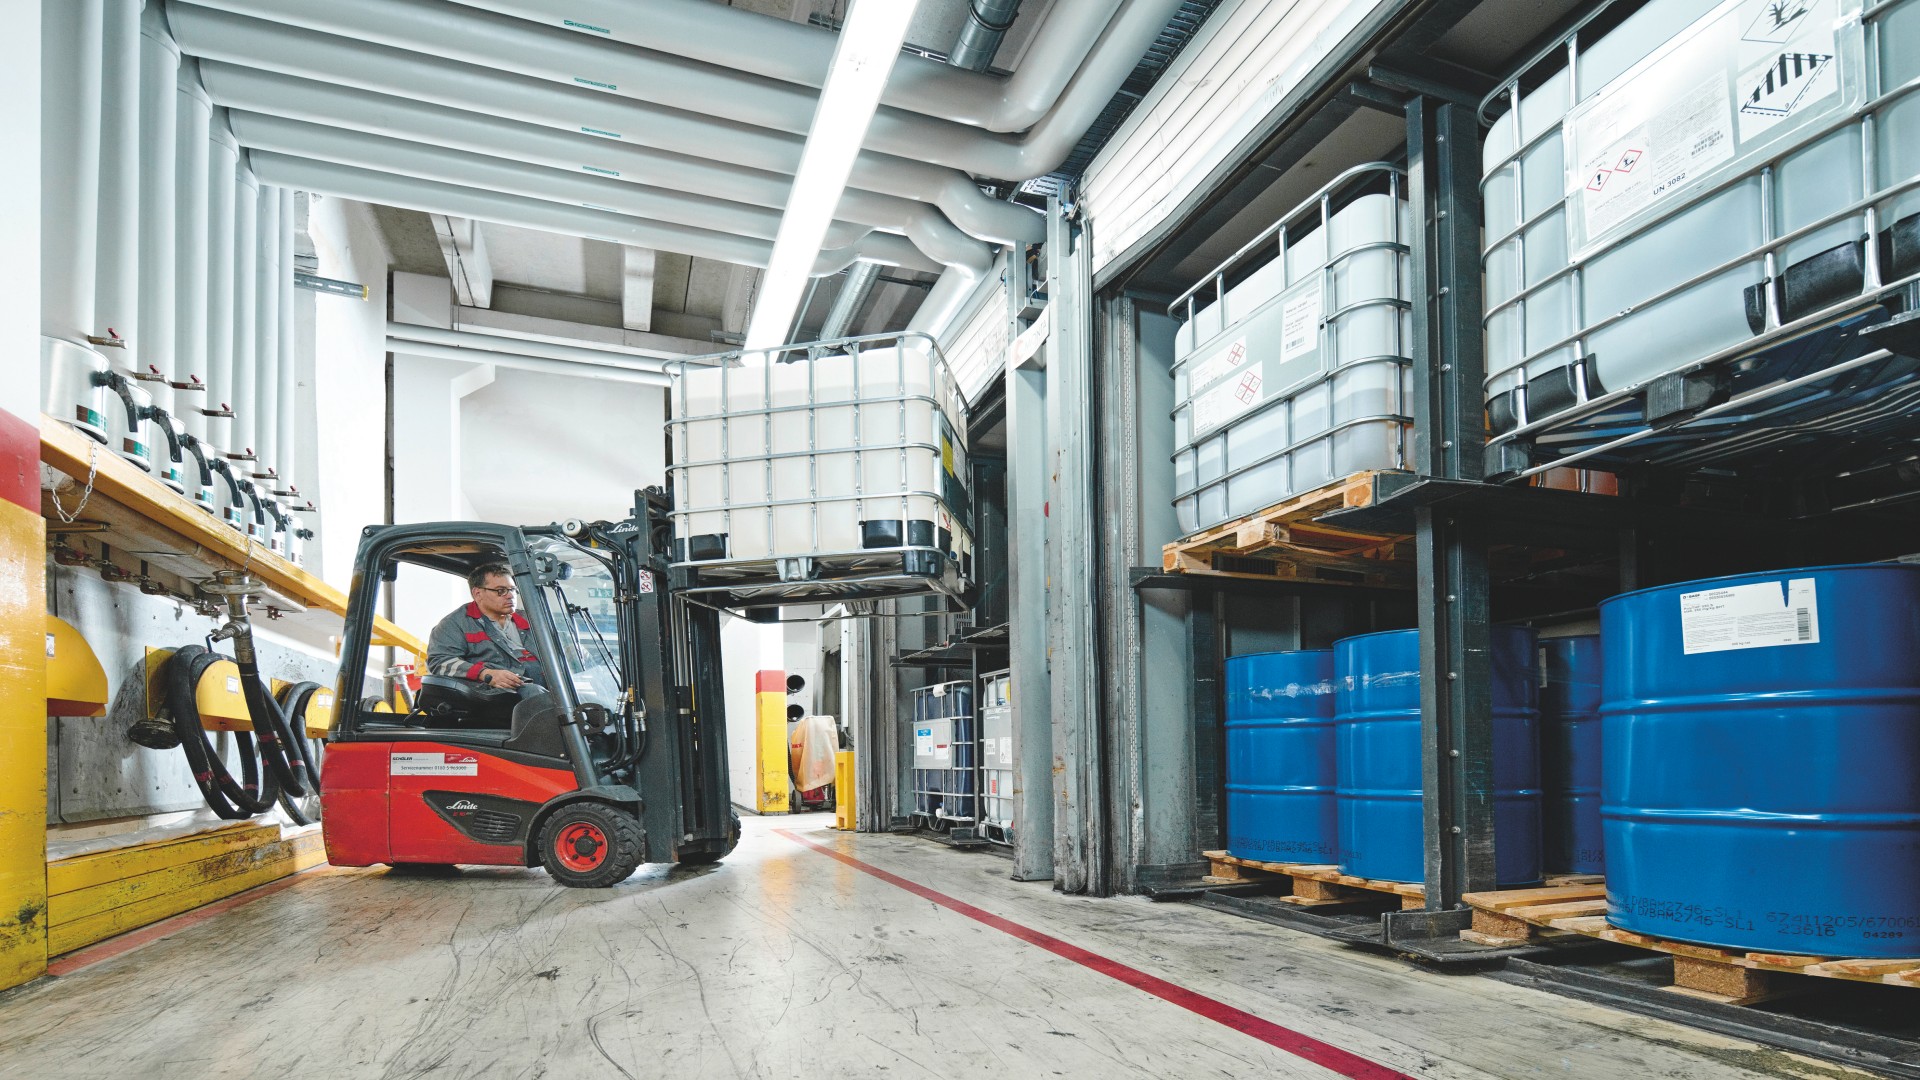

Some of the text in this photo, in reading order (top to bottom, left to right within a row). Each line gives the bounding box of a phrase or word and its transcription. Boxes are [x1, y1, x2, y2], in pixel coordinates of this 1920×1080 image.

[1653, 172, 1686, 195] UN 3082
[606, 522, 639, 534] Linde
[446, 799, 478, 810] Linde
